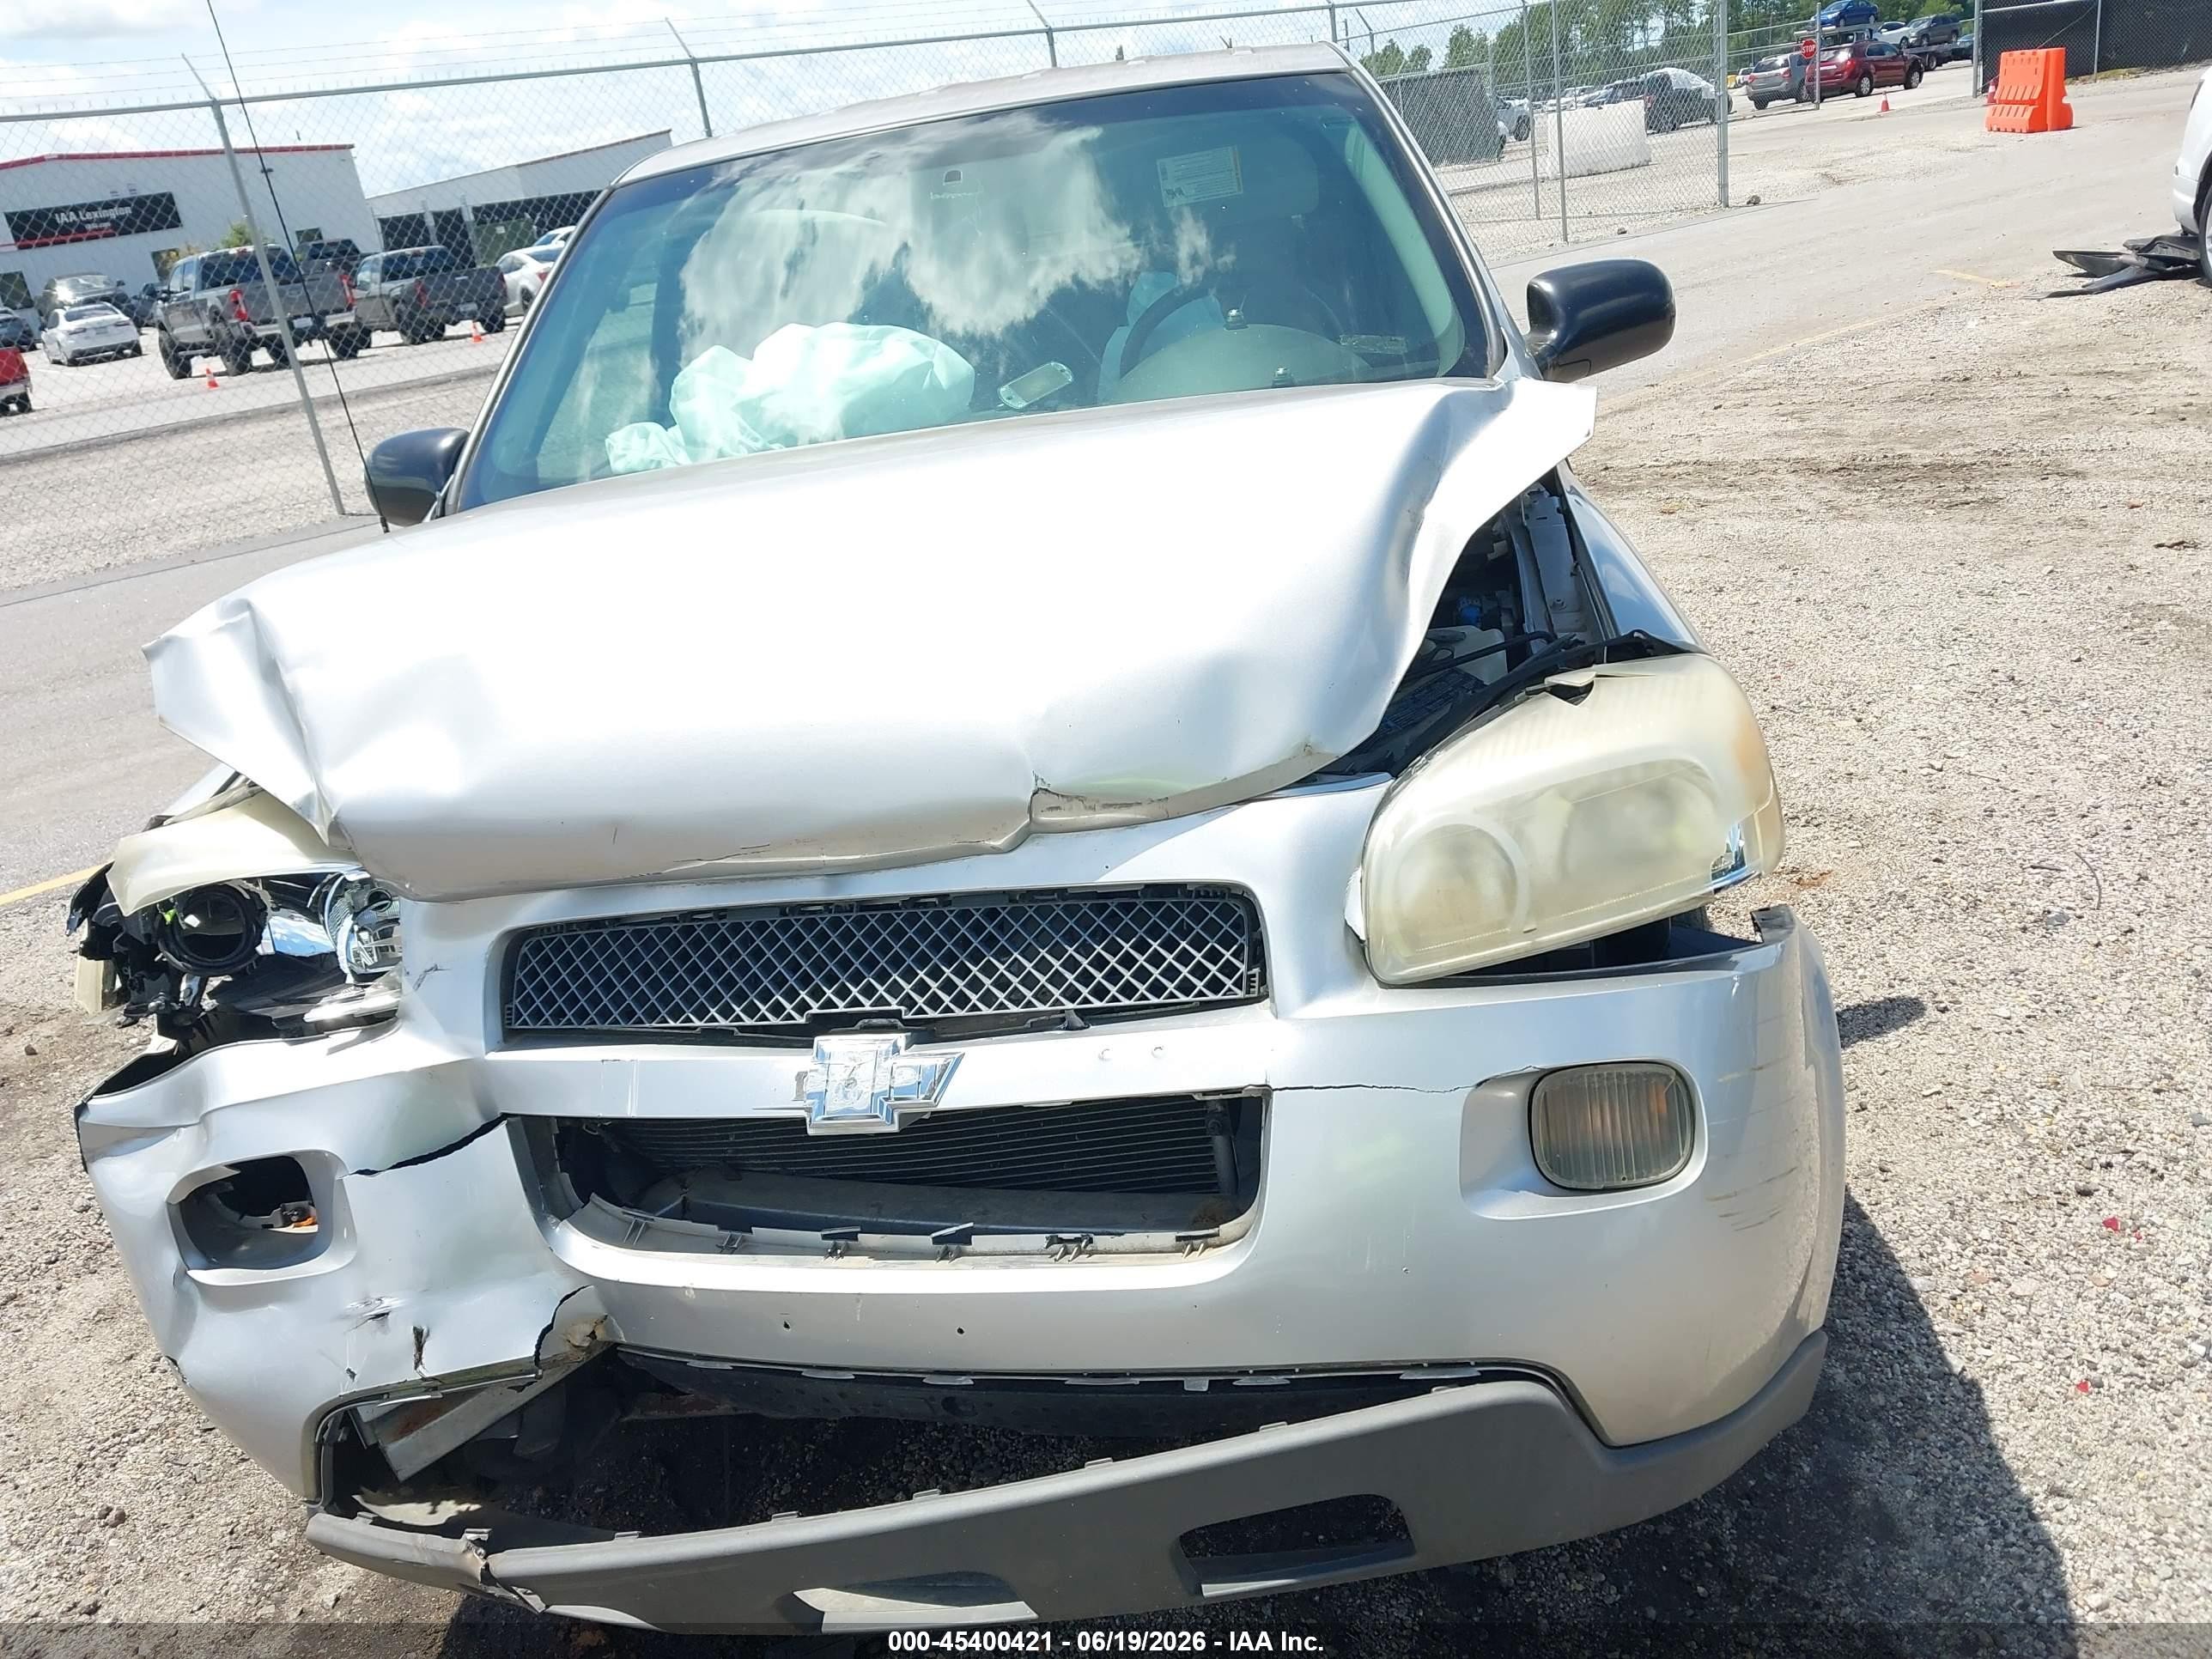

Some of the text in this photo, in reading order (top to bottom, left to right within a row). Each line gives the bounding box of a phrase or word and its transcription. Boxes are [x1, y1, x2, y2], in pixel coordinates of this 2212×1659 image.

[1802, 45, 1816, 53] STOP
[55, 207, 131, 224] IAA Lexington
